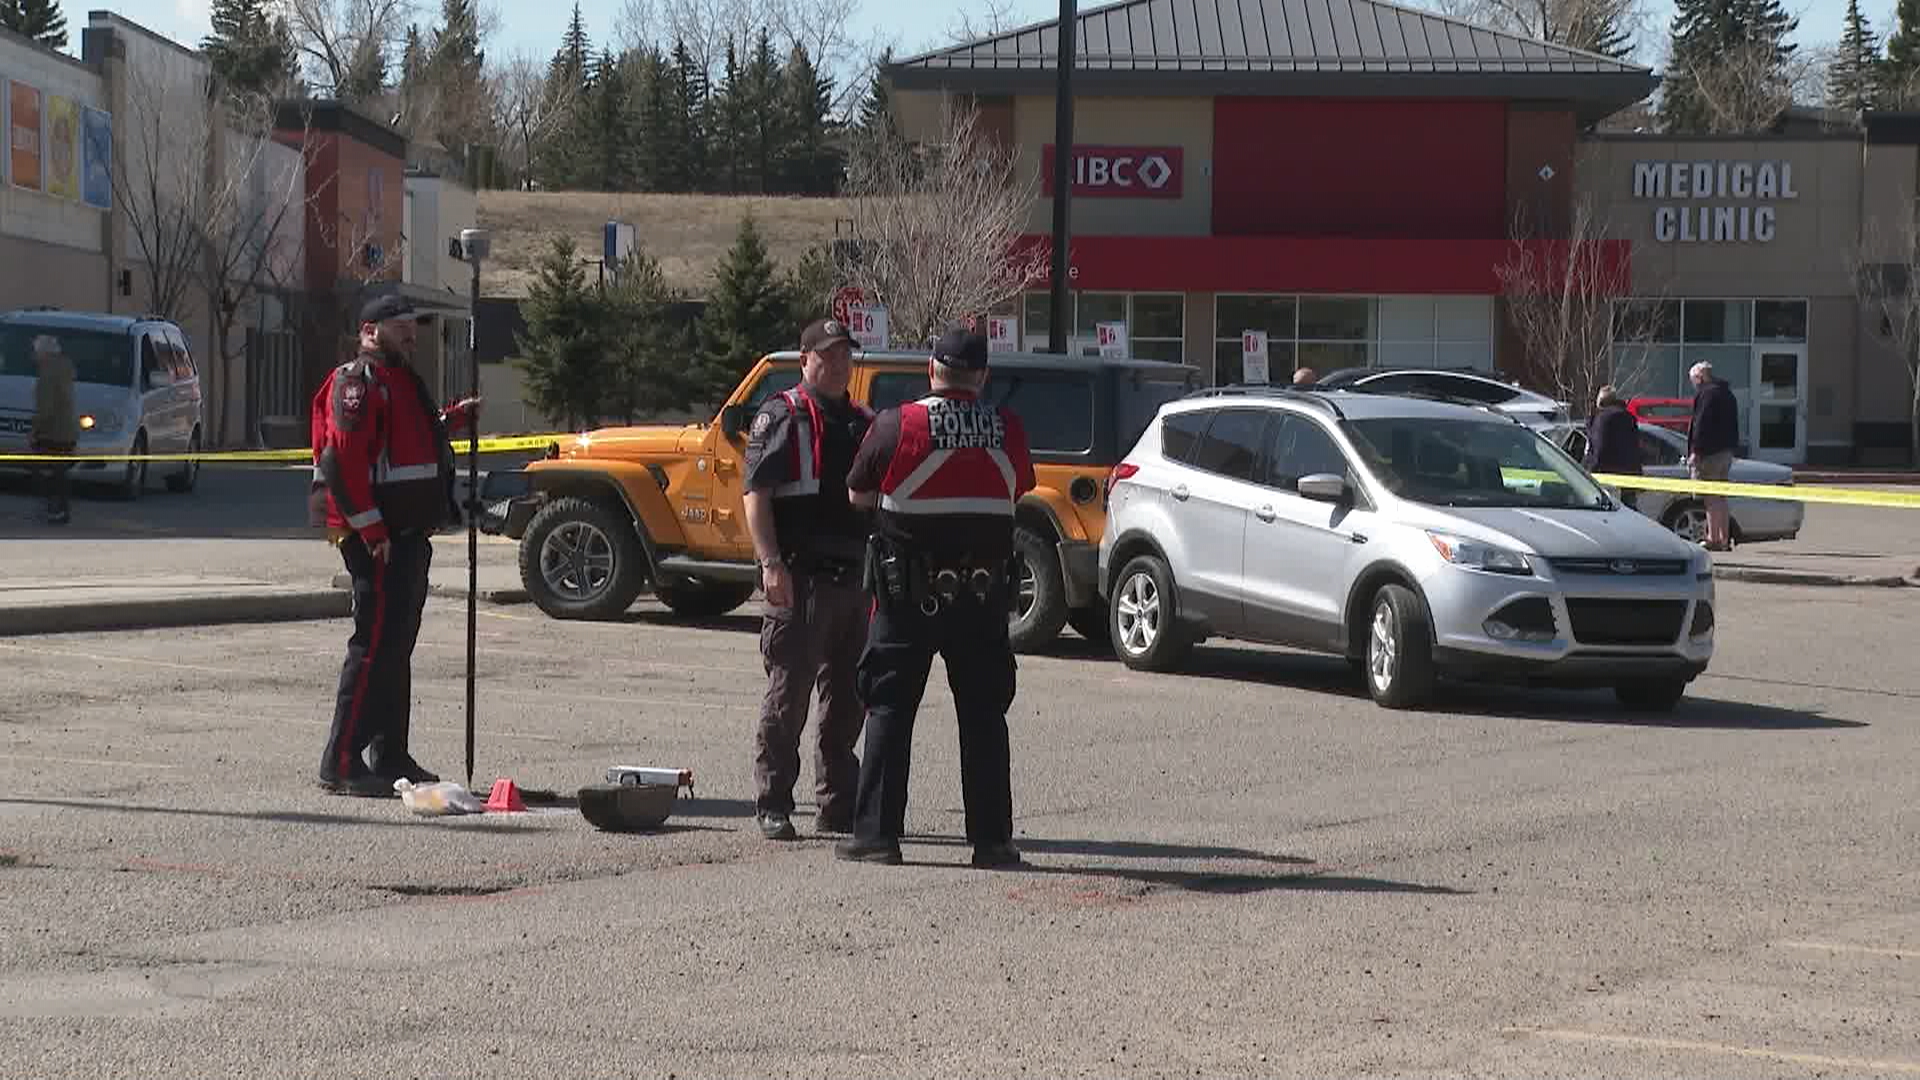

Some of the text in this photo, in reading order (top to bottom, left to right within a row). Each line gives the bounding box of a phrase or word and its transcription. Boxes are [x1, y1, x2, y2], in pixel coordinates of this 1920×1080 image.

[1072, 156, 1134, 187] IBC
[1633, 162, 1799, 198] MEDICAL
[1655, 206, 1776, 242] CLINIC
[929, 412, 1005, 436] POLICE
[936, 434, 1002, 448] TRAFFIC
